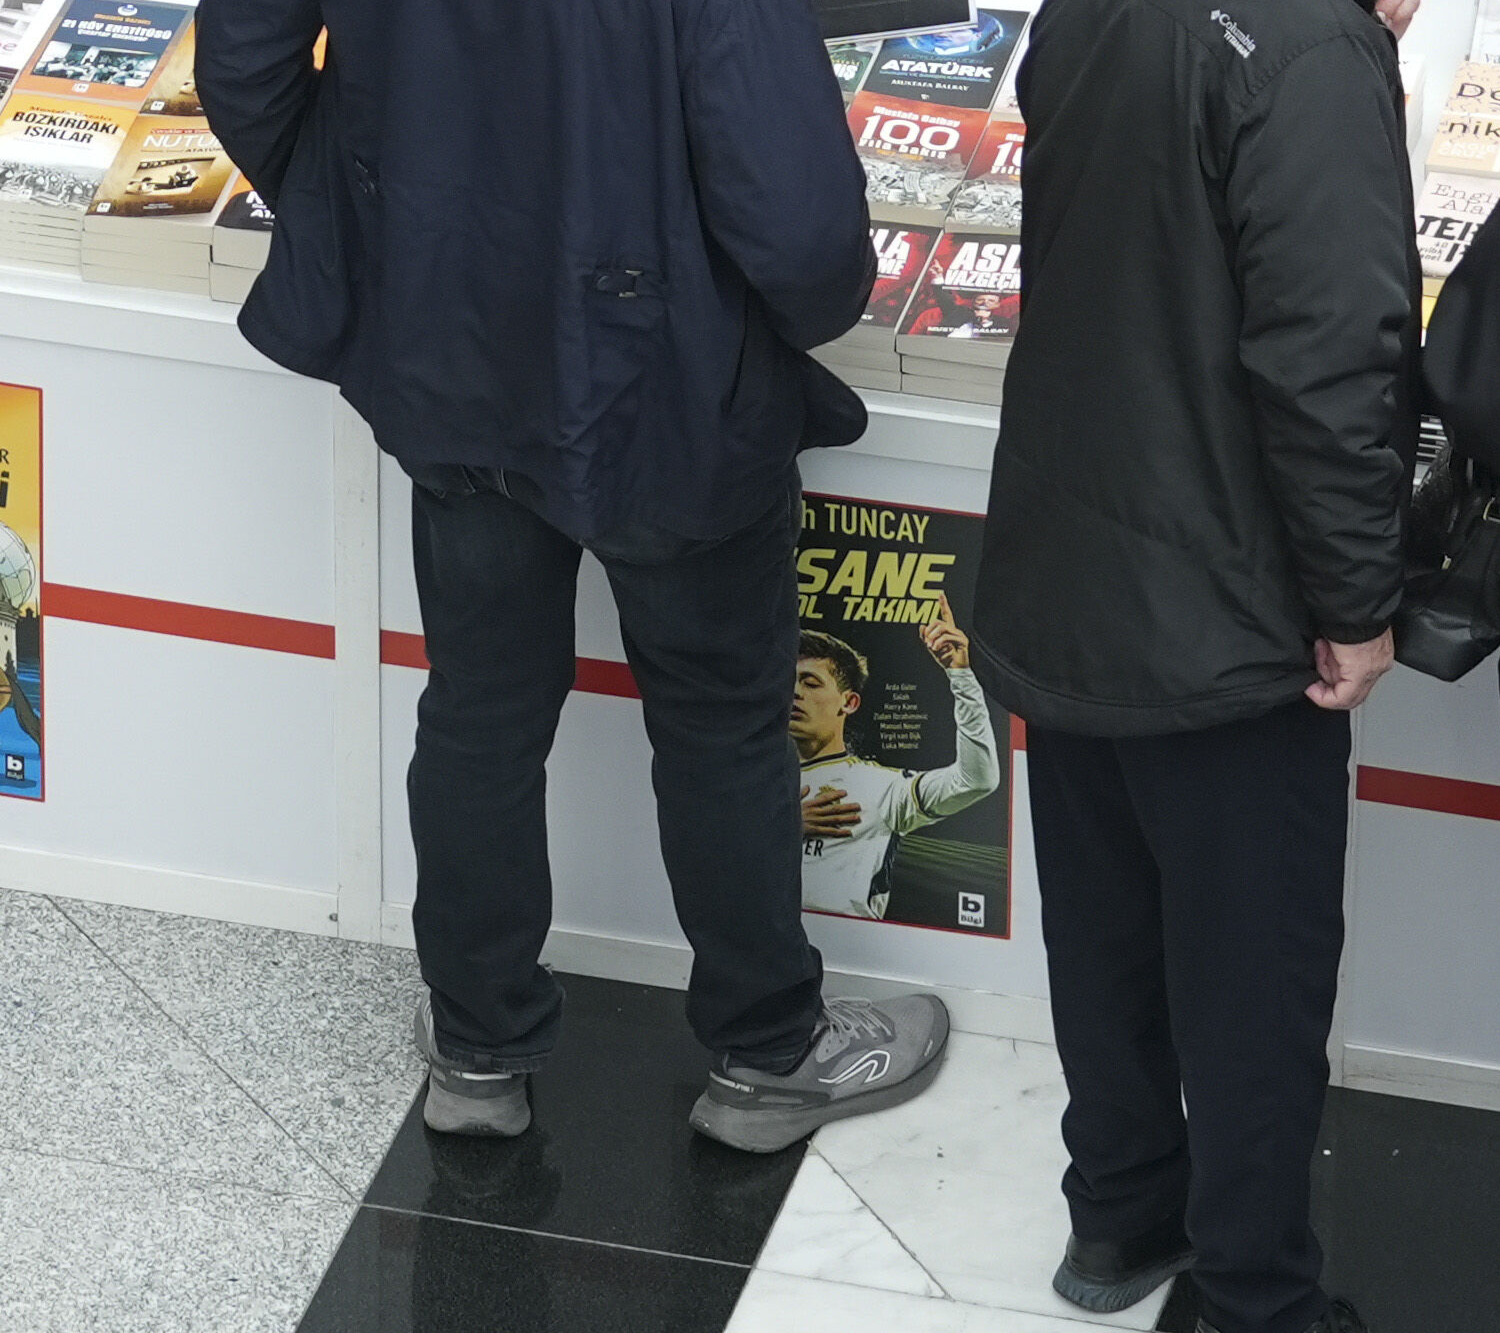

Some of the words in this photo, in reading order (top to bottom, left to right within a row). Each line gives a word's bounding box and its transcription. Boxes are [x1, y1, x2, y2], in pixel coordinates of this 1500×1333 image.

[880, 57, 995, 81] ATATÜRK
[143, 132, 223, 150] NUTU
[861, 114, 961, 153] 100
[1431, 183, 1494, 205] Engi
[949, 241, 1021, 273] ASL
[825, 502, 930, 544] TUNCAY
[797, 546, 956, 600] SANE
